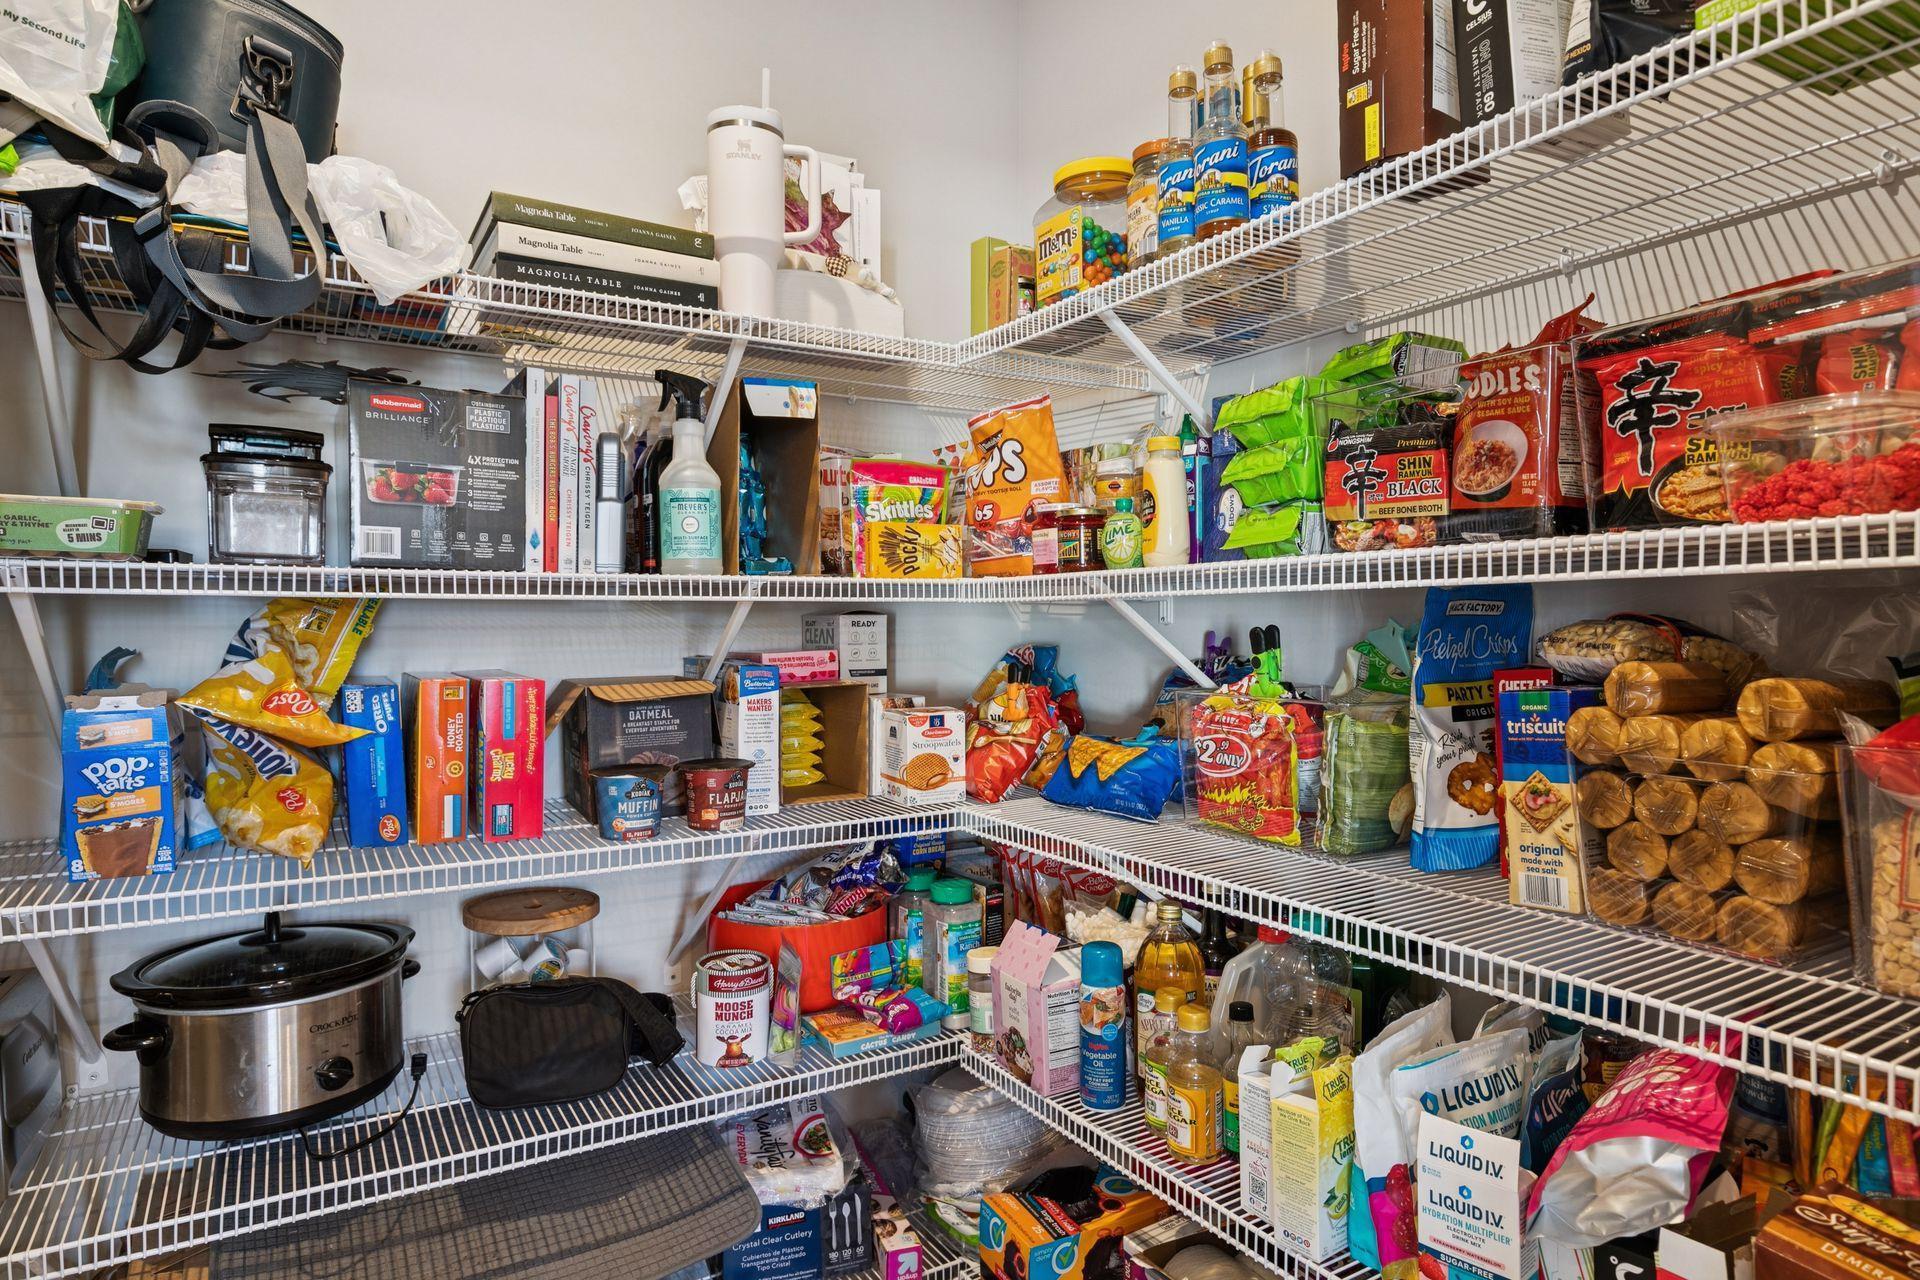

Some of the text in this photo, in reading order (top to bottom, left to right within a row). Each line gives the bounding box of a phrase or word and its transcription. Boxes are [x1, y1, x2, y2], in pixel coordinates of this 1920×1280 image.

[1466, 9, 1493, 32] CELSIUS
[3, 9, 86, 50] My Second Life
[1352, 26, 1360, 75] Sugar Free
[1569, 43, 1591, 60] MEXICO
[1472, 46, 1483, 118] VARIETY PACK
[1484, 91, 1495, 113] GO
[725, 152, 762, 160] STANLEY
[1209, 196, 1244, 207] CARAMEL
[514, 203, 577, 223] Magnolia Table
[1161, 216, 1189, 228] VANILLA
[631, 227, 678, 240] JOANNA GAINES
[518, 235, 583, 255] Magnolia Table
[517, 265, 623, 289] MAGNOLIA TABLE
[633, 285, 681, 297] JOANNA GAINES
[1852, 346, 1866, 381] SHIN
[1864, 343, 1880, 378] RAMYUN
[372, 397, 422, 409] Rubbermaid
[1477, 401, 1496, 409] WITH
[365, 411, 430, 424] BRILLIANCE
[563, 384, 580, 443] Cravings
[1477, 406, 1531, 417] SESAME SAUCE
[1606, 356, 1702, 476] 辛
[469, 416, 507, 424] PLASTIQUE
[579, 405, 597, 475] Cravings
[1338, 436, 1373, 446] NONGSHIM
[1397, 438, 1436, 448] Premium
[467, 456, 482, 466] 4X
[482, 457, 520, 465] PROTECTION
[1397, 455, 1434, 471] SHIN
[1398, 469, 1433, 479] RAMYUN
[1341, 444, 1389, 522] 辛
[1386, 478, 1443, 498] BLACK
[677, 503, 708, 511] MEYER'S
[864, 500, 935, 523] Skittles
[975, 503, 995, 521] 65
[1378, 504, 1443, 515] BEEF BONE BROTH
[4, 514, 41, 522] GARLIC,
[19, 521, 50, 529] THYME
[75, 532, 103, 543] MINS
[1104, 523, 1135, 546] LIME
[1466, 602, 1502, 613] FACTORY
[851, 620, 877, 628] READY
[804, 628, 836, 645] CLEAN
[1420, 624, 1518, 675] Pretzel Crisps
[743, 679, 775, 689] Buttermilk
[1447, 685, 1484, 702] PARTY
[267, 691, 315, 715] Post
[747, 698, 772, 706] MAKERS
[372, 695, 389, 735] OREO
[629, 709, 673, 721] OATMEAL
[455, 712, 464, 752] ROASTED
[625, 725, 678, 734] EVERYDAY ADVENTURES
[627, 720, 653, 728] BREAKFAST
[1506, 718, 1566, 734] triscuit
[447, 717, 456, 748] HONEY
[912, 738, 962, 750] Stroopwafels
[490, 748, 503, 782] Charms
[502, 752, 515, 780] Lucky
[1215, 752, 1245, 769] ONLY
[95, 774, 146, 796] tarts
[279, 787, 304, 810] Post
[630, 790, 652, 798] KODIAK
[110, 797, 146, 809] S'MORES
[617, 798, 658, 815] MUFFIN
[381, 818, 398, 838] Post
[1519, 843, 1564, 858] original
[71, 859, 84, 873] 8
[1520, 856, 1564, 868] made with
[964, 866, 992, 877] Quick
[1526, 866, 1558, 876] sea salt
[959, 940, 981, 951] Ranch
[714, 979, 738, 992] Harry
[1047, 991, 1070, 999] Nutrition
[714, 1000, 754, 1012] MOOSE
[1048, 1008, 1066, 1016] Calories
[714, 1009, 754, 1022] MUNCH
[861, 1032, 917, 1050] CACTUS CANDY
[1082, 1051, 1117, 1060] Vegetable
[1325, 1073, 1345, 1092] TRUE
[1441, 1063, 1523, 1112] LIQUID I.V.
[1329, 1083, 1349, 1100] lemon
[736, 1123, 748, 1166] EVERYDAY
[1247, 1145, 1270, 1159] AMERICA
[1429, 1141, 1504, 1180] LIQUID I.V.
[1429, 1189, 1504, 1230] LIQUID I.V.
[768, 1211, 805, 1226] KIRKLAND
[1421, 1205, 1512, 1247] HYDRATION MULTIPLIER
[1031, 1224, 1045, 1235] 25
[1051, 1220, 1067, 1236] trash
[1446, 1224, 1486, 1244] ELECTROLYTE
[1795, 1205, 1903, 1256] Sugar
[732, 1229, 813, 1252] Crystal Clear Cutlery
[1451, 1233, 1482, 1249] DRINK MIX
[740, 1250, 806, 1269] Transparente Acabado
[742, 1251, 770, 1262] Cubiertos
[780, 1244, 804, 1255] Plástico
[828, 1245, 865, 1260] 180 120 60
[1034, 1246, 1054, 1258] simply
[1036, 1253, 1051, 1262] done
[1432, 1238, 1502, 1269] STRAWBERRY WATERMELON
[756, 1260, 791, 1273] Tipo Cristal
[1440, 1253, 1494, 1280] SUGAR-FREE
